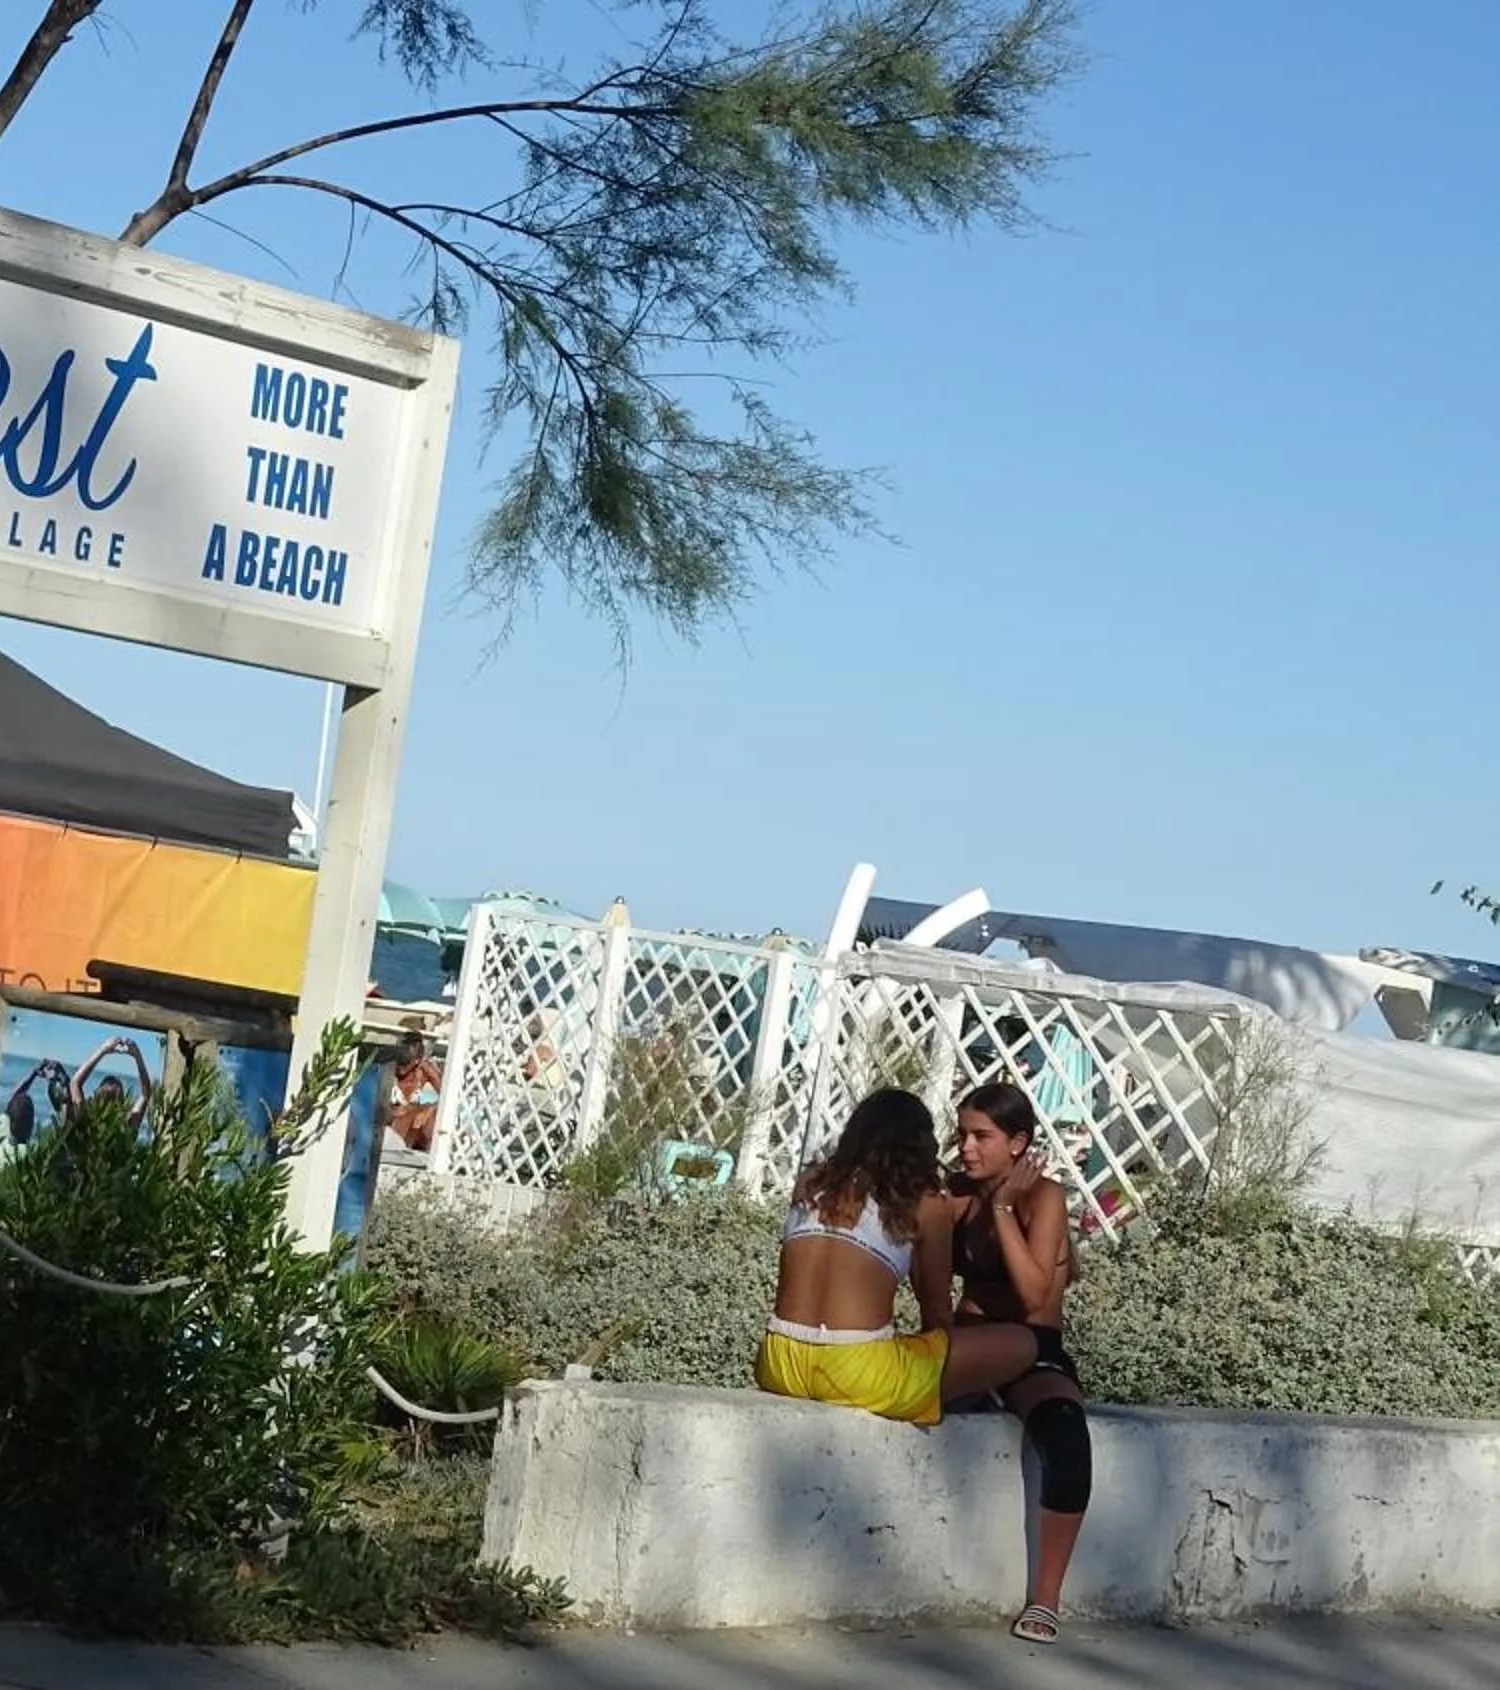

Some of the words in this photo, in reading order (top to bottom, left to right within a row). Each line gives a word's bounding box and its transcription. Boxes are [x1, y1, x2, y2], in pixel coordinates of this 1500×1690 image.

[251, 362, 349, 440] MORE
[246, 446, 335, 520] THAN
[201, 523, 228, 581] A
[235, 529, 349, 607] BEACH
